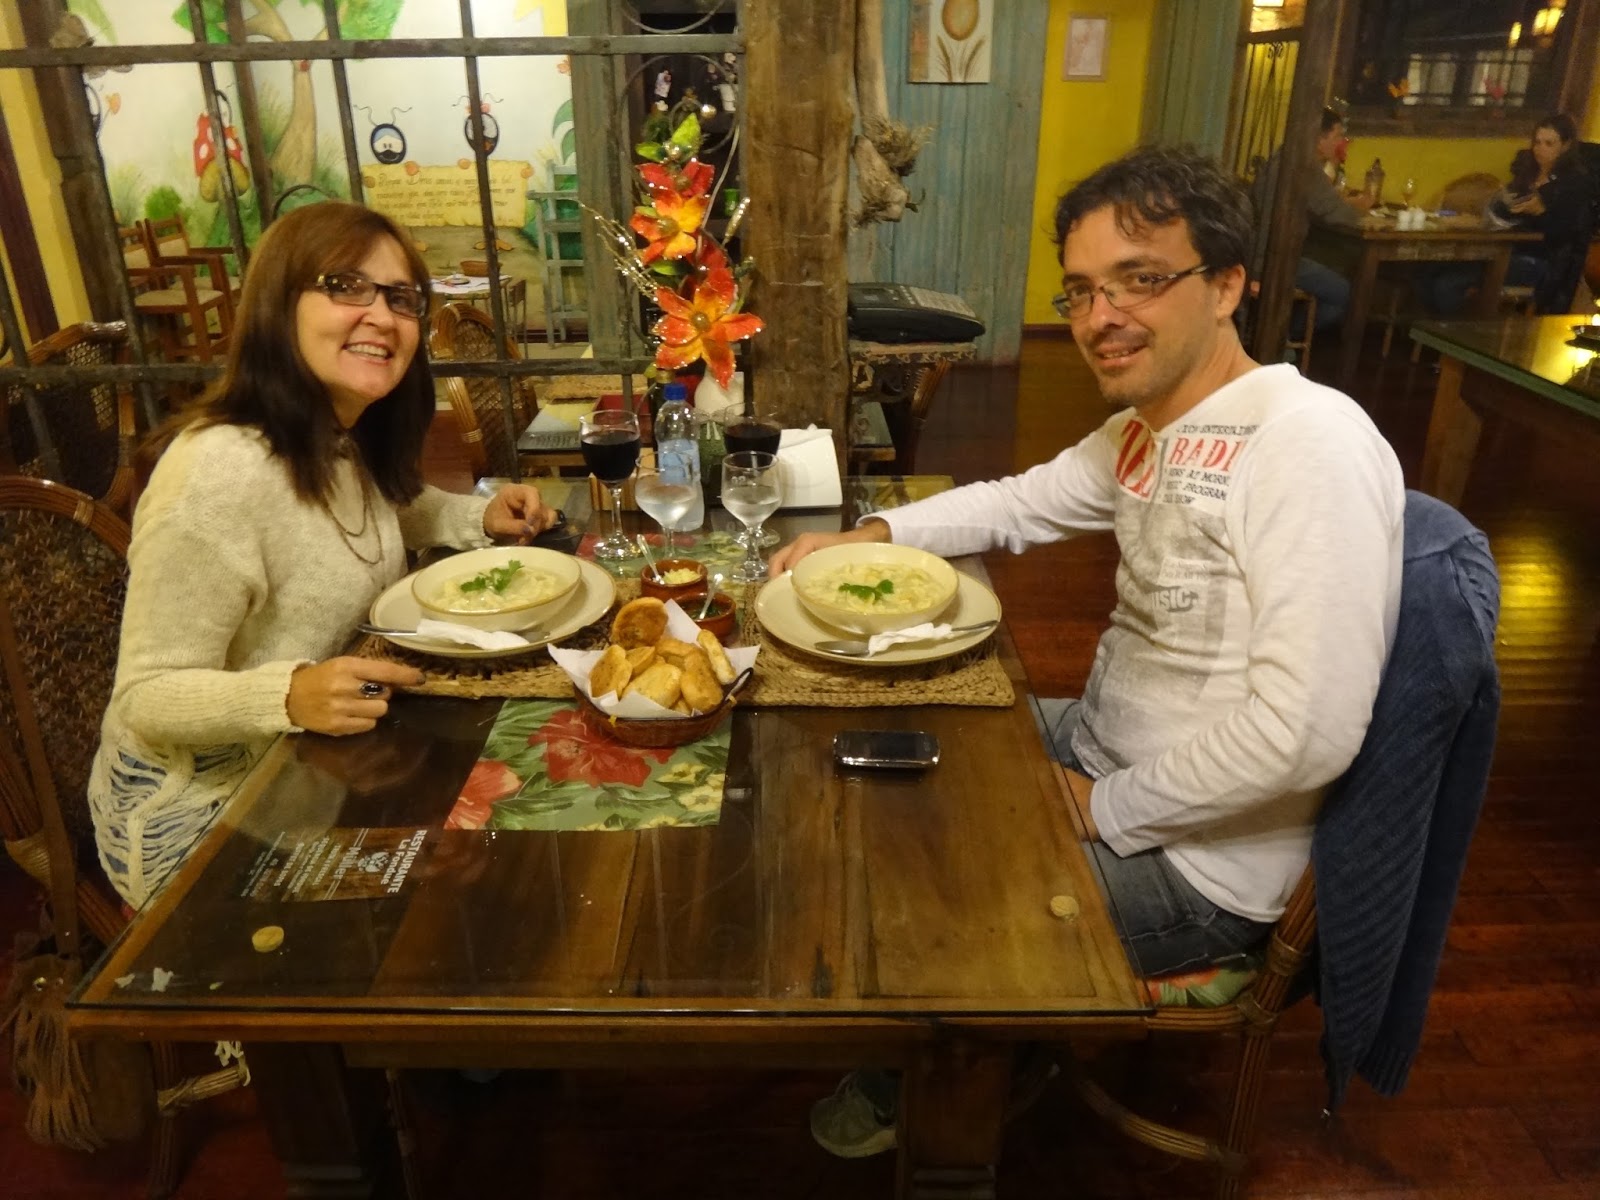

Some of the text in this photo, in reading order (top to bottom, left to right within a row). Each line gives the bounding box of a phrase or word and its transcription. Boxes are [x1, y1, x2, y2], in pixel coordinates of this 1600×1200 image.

[333, 846, 362, 880] Müller
[380, 838, 411, 886] La Fondue
[387, 829, 428, 894] RESTAURANTE
